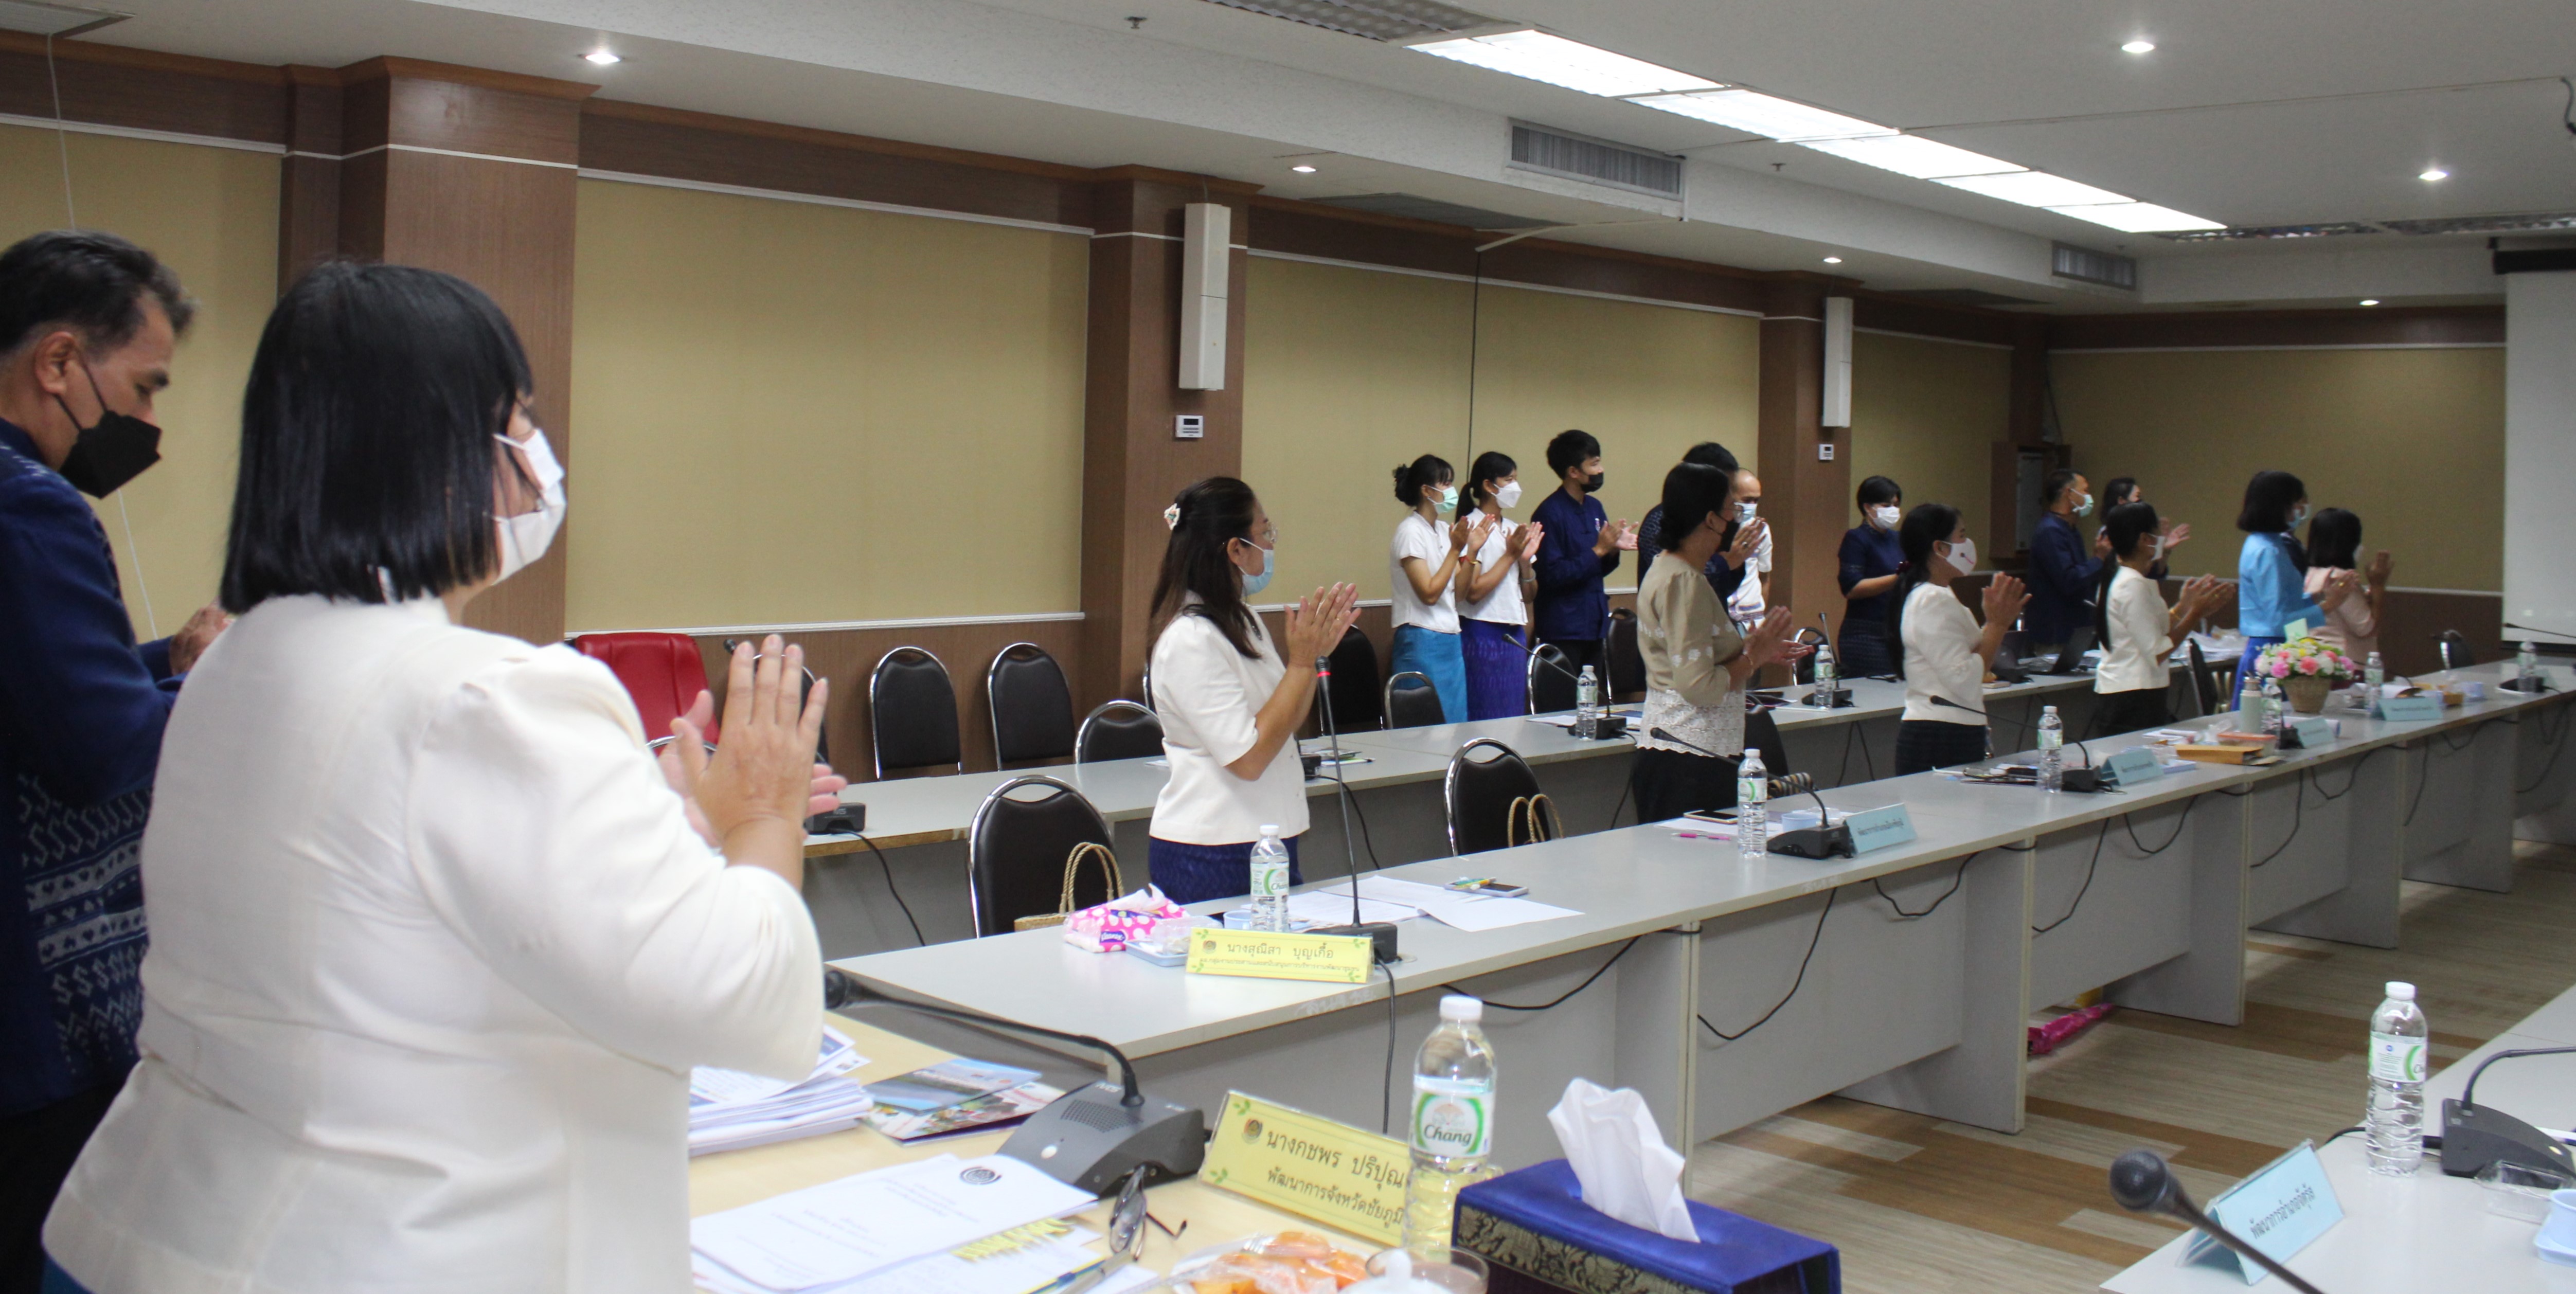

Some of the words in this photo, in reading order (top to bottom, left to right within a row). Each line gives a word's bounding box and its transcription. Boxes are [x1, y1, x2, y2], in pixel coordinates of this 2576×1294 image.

[1227, 942, 1281, 958] นางสุณิสา
[1293, 942, 1334, 960] บุญเกื้อ
[1424, 1124, 1473, 1147] Chang
[1266, 1129, 1342, 1169] นางกชพร
[1351, 1154, 1405, 1190] ปริปุณ
[1267, 1166, 1404, 1229] พัฒนาการจังหวัดชัยภูมิ
